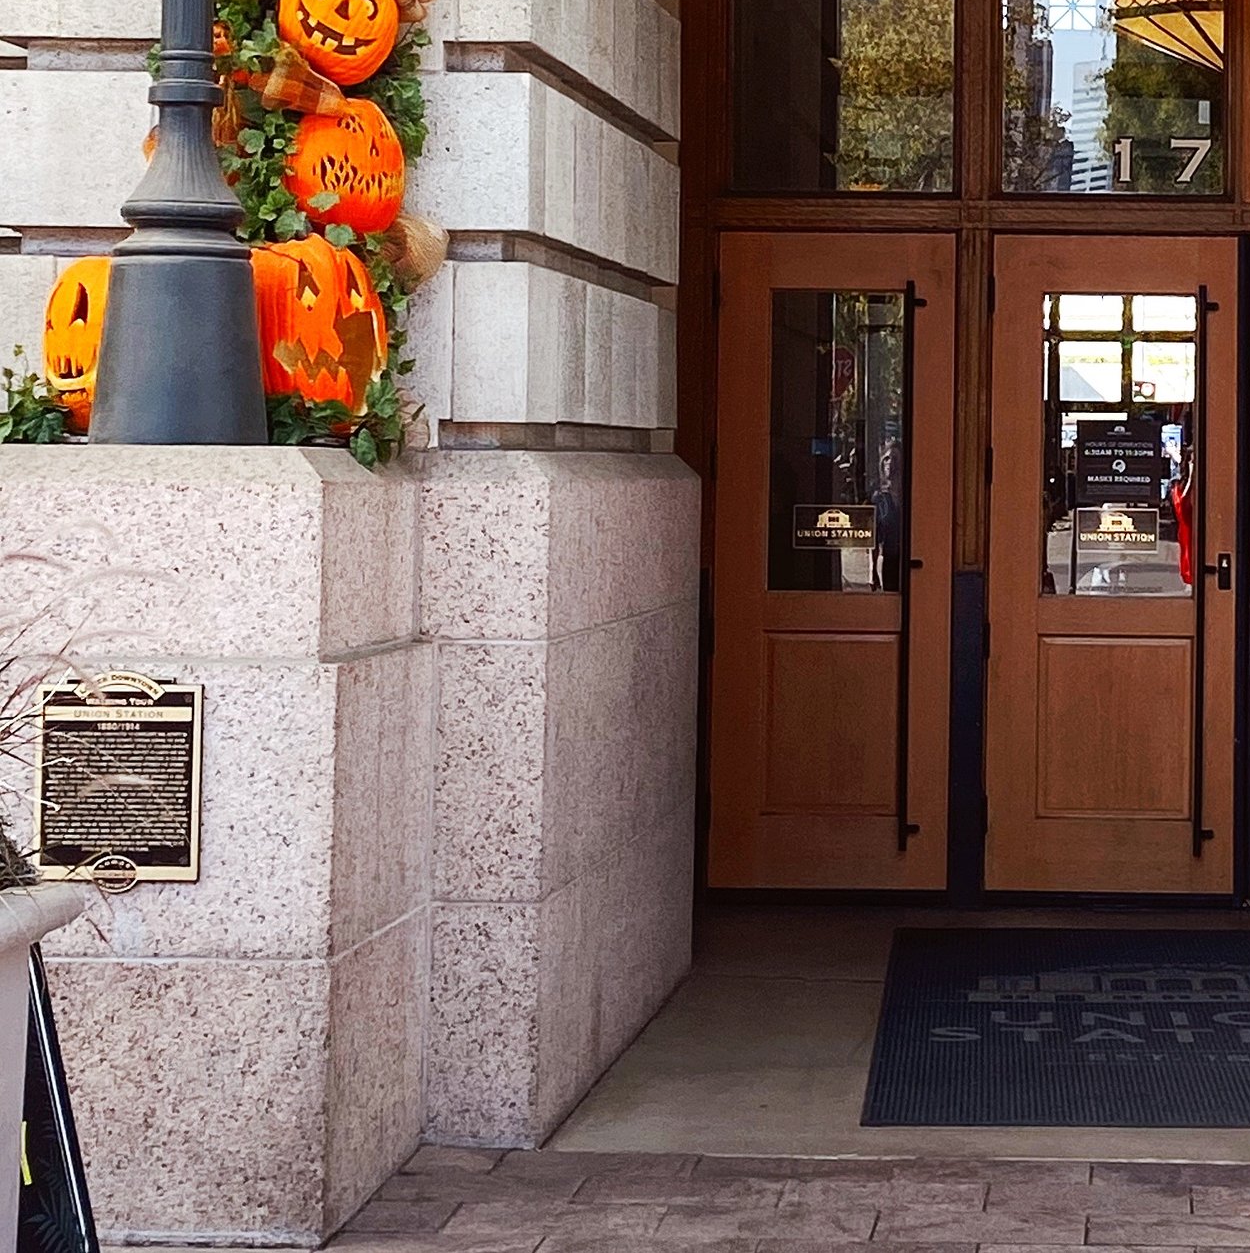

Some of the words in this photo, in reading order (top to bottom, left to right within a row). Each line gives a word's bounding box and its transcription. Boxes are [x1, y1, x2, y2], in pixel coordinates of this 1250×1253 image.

[797, 530, 828, 538] UNION
[831, 530, 872, 538] STATION
[1080, 533, 1112, 542] UNION
[1115, 533, 1155, 542] STATION
[111, 674, 159, 695] DOWNTOWN
[74, 709, 110, 718] UNION
[116, 709, 164, 718] STATION
